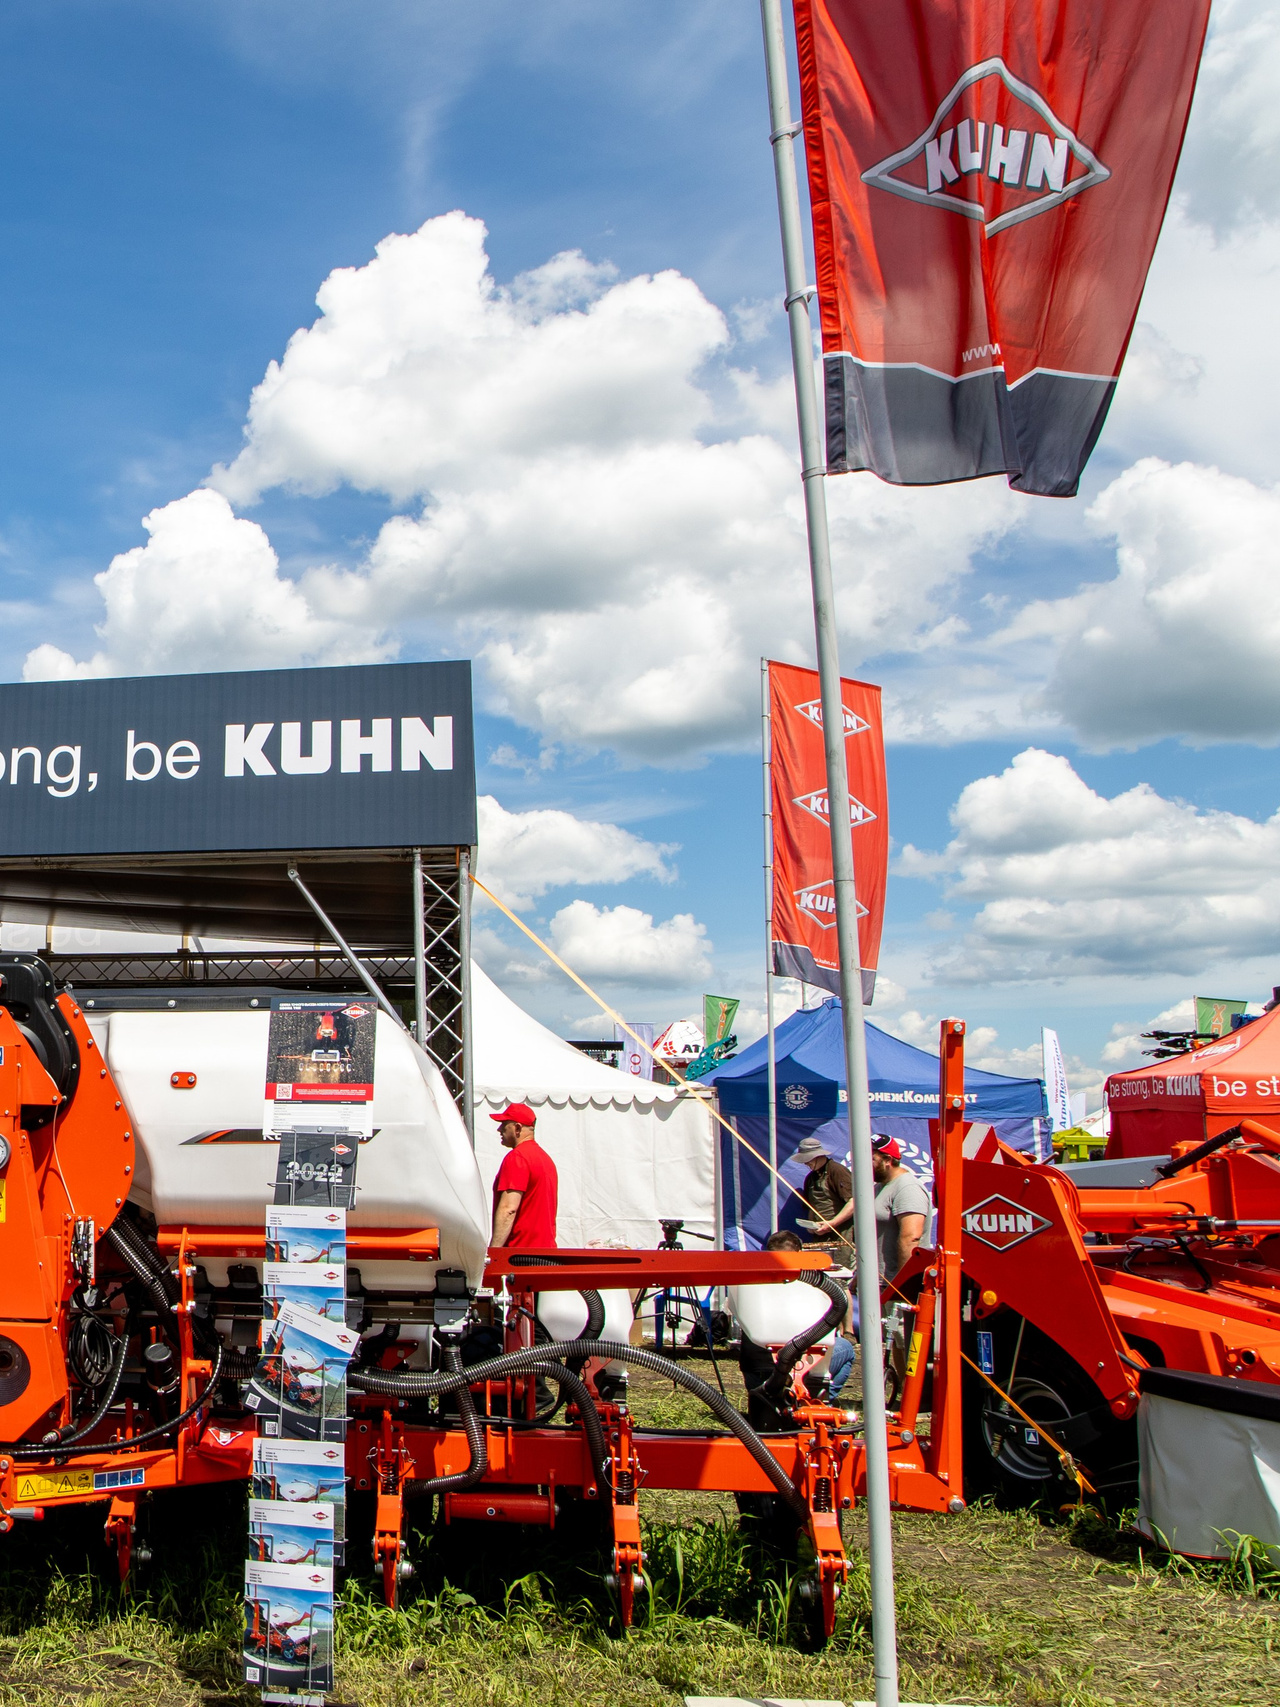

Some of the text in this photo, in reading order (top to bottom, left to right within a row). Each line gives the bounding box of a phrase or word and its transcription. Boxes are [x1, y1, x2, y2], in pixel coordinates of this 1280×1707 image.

[925, 118, 1068, 194] KUHN
[809, 705, 858, 729] KN
[125, 730, 200, 782] be
[224, 715, 453, 777] KUHN
[811, 796, 864, 820] KN
[800, 892, 837, 913] KUH
[1110, 1075, 1201, 1099] be strong, be KUHN
[1213, 1076, 1247, 1097] be
[286, 1161, 343, 1183] 2022
[966, 1214, 1033, 1233] KUHN
